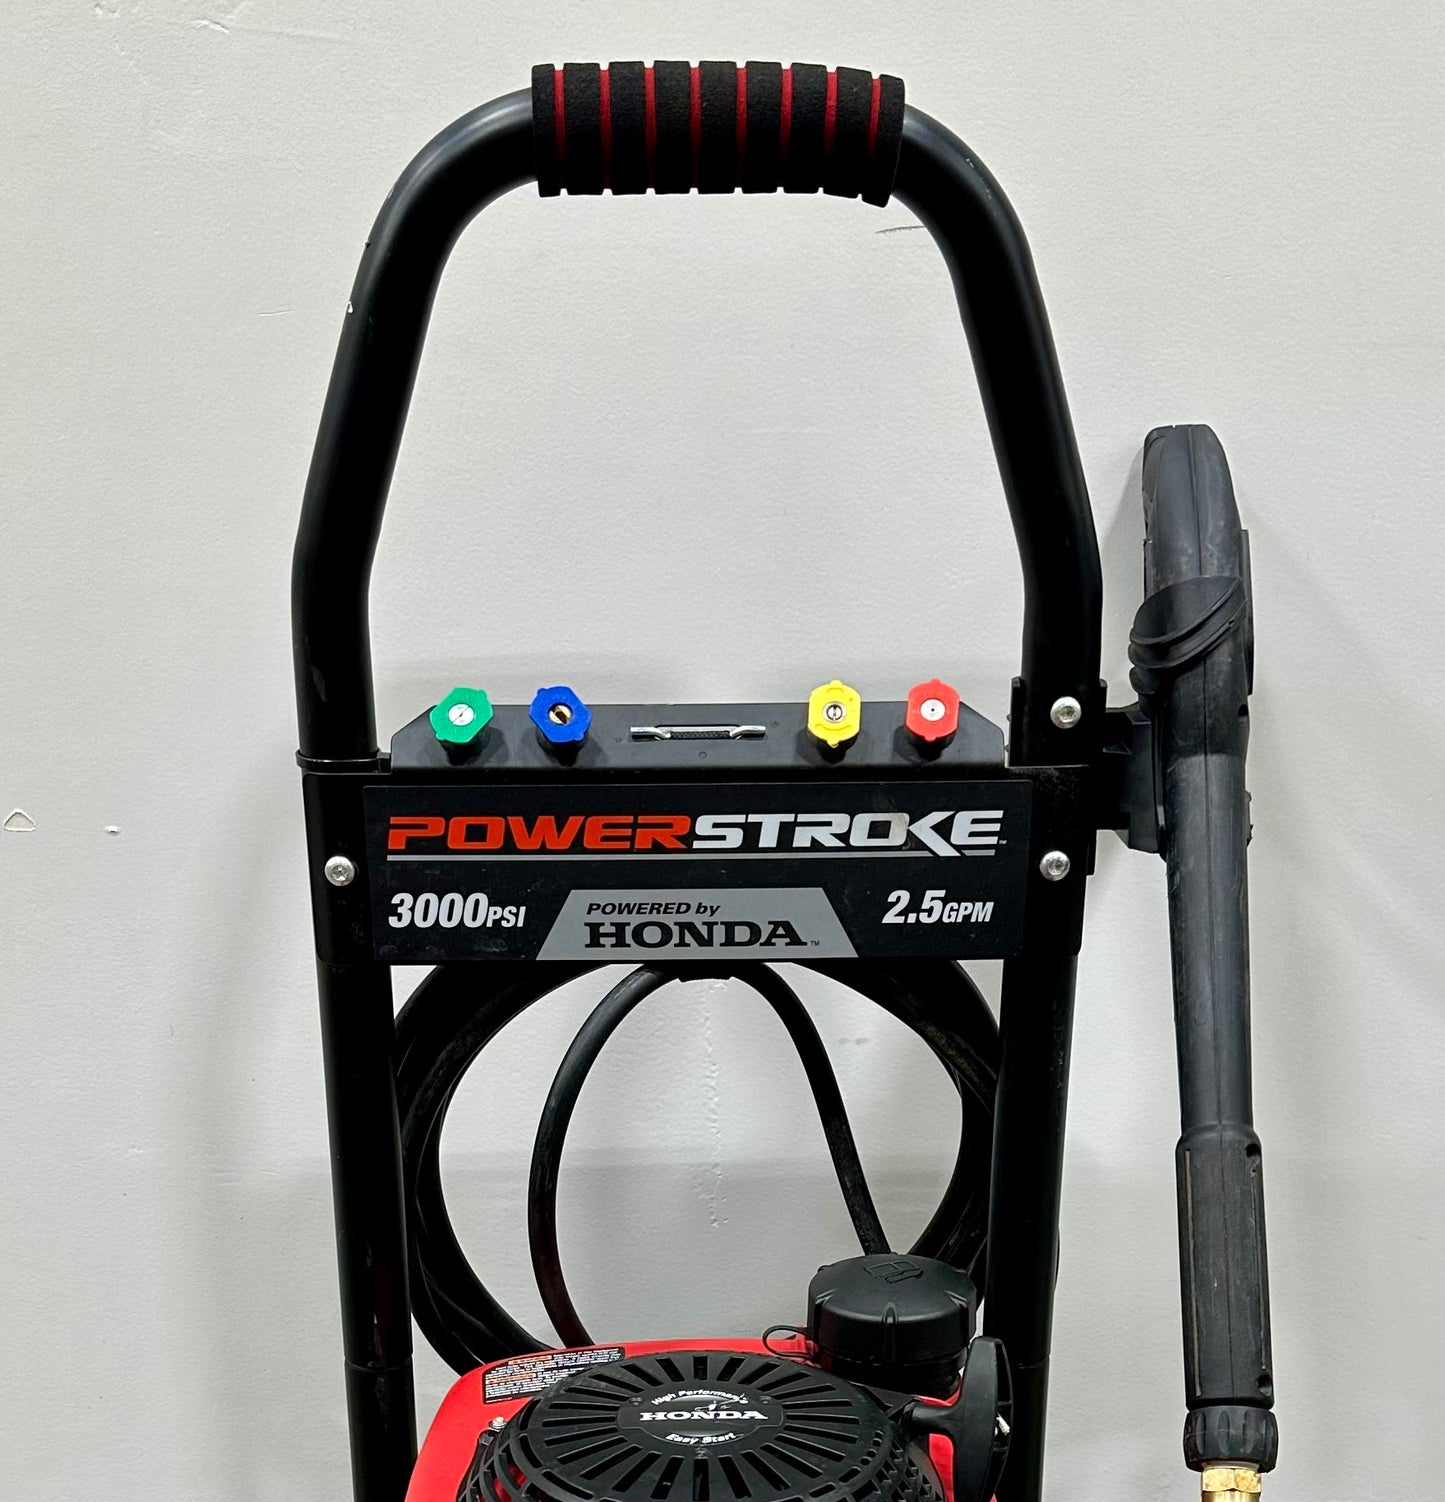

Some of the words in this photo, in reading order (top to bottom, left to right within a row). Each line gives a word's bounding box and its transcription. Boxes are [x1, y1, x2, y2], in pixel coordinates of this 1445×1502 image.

[388, 810, 1003, 857] POWERSTROKE
[388, 892, 526, 928] 3000PSI
[586, 902, 691, 915] POWERED
[695, 901, 721, 917] by
[882, 890, 994, 924] 2.5GPM
[584, 920, 808, 948] HONDA
[651, 1393, 676, 1406] High
[640, 1410, 768, 1421] HONDA
[665, 1432, 699, 1445] Easy
[701, 1432, 737, 1444] Start
